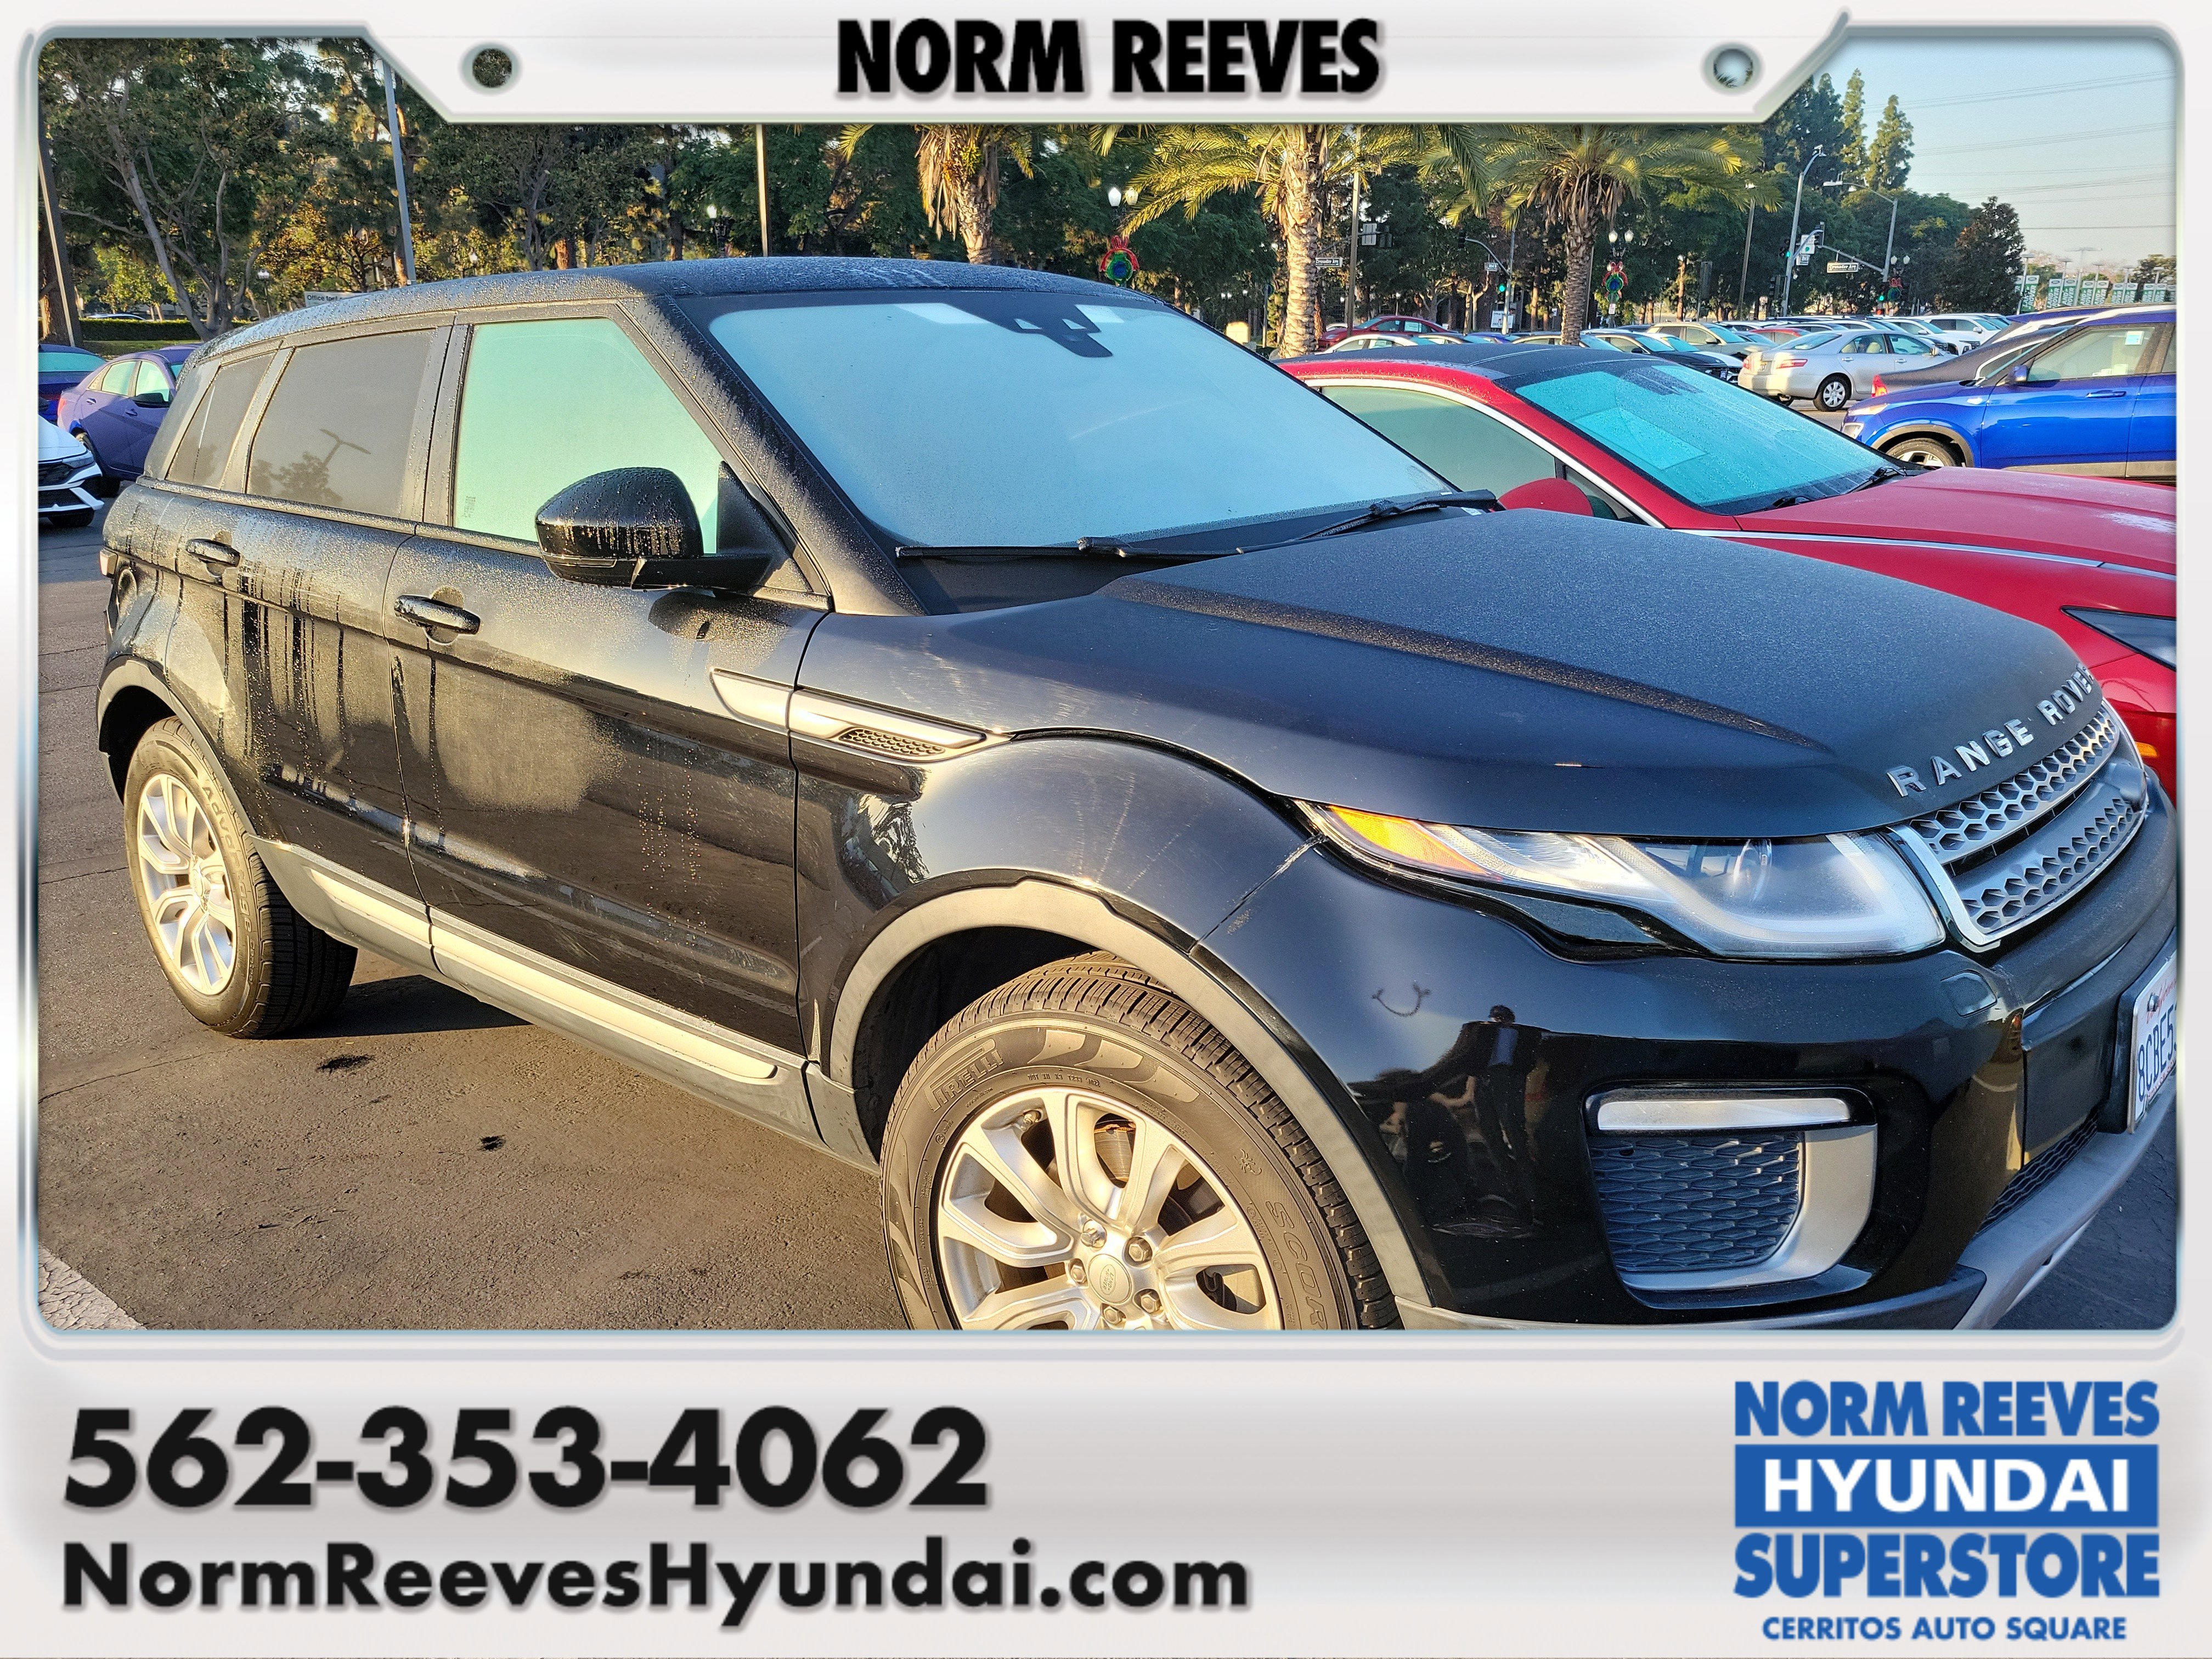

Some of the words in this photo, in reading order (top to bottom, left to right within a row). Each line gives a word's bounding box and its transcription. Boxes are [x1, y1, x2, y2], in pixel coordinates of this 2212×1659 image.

[1886, 718, 2034, 798] RANGE
[923, 1039, 1005, 1113] PIRELLI
[2138, 1000, 2177, 1102] 8CBE5
